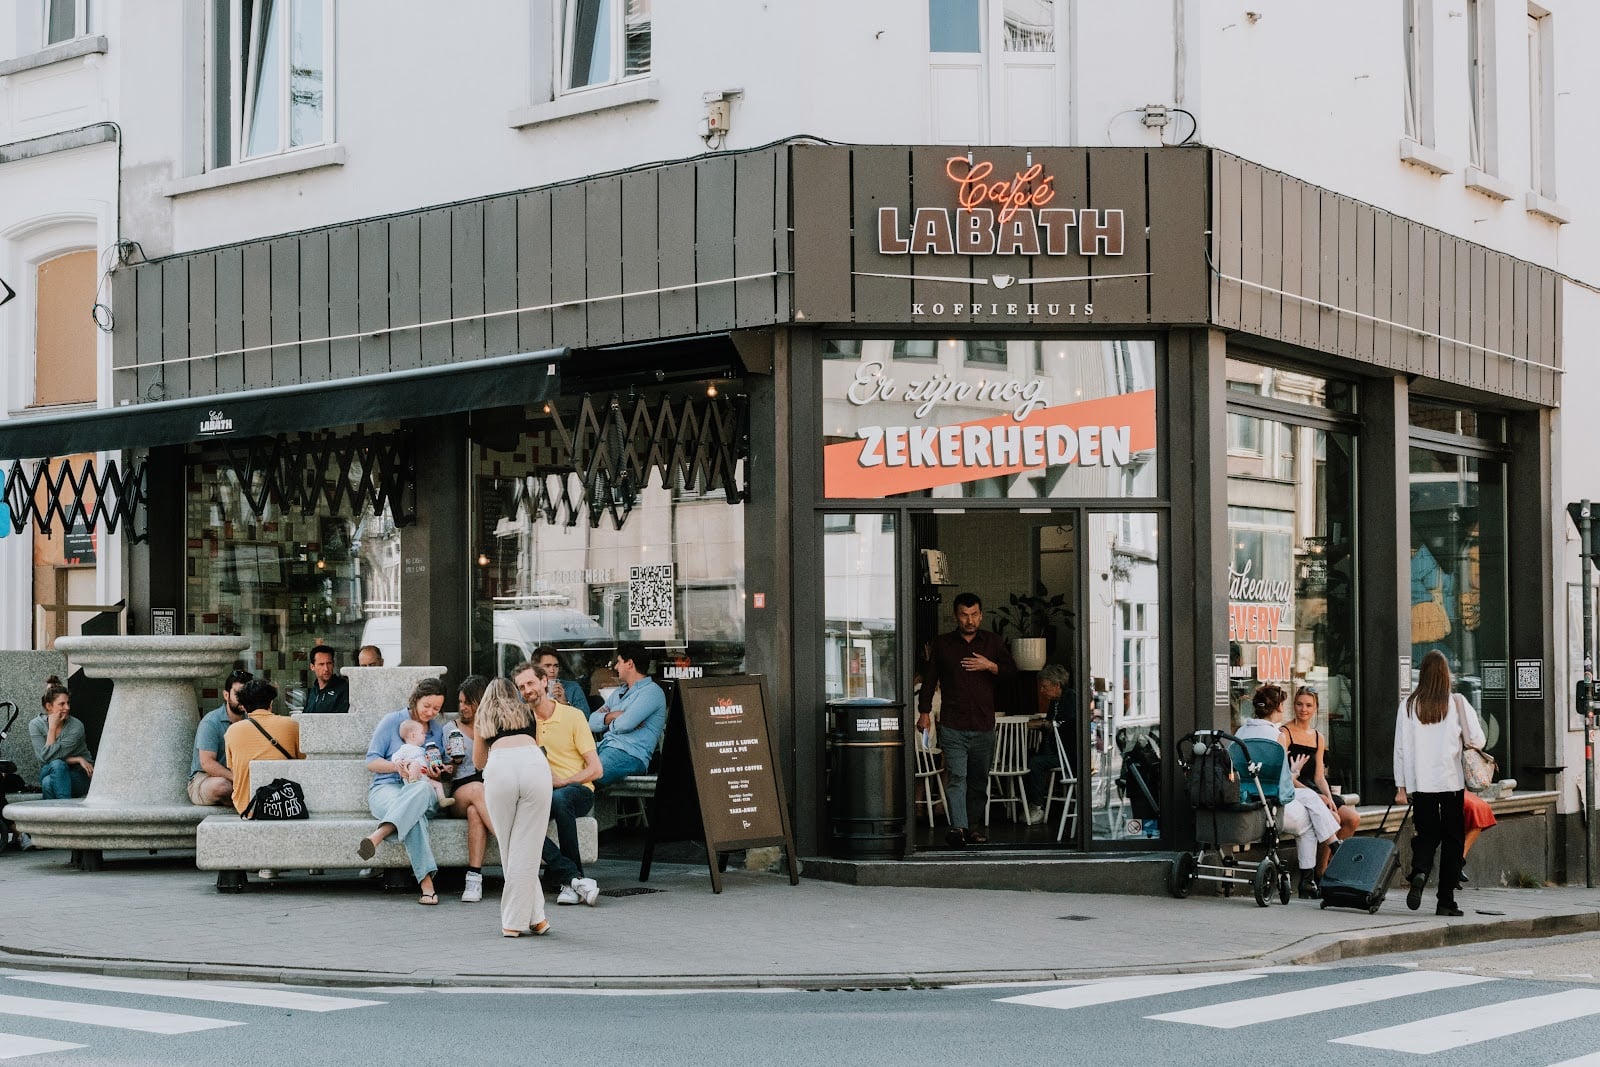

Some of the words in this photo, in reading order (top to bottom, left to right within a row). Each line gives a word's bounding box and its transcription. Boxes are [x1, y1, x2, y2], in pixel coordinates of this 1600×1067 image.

[946, 156, 1055, 223] Café
[878, 206, 1125, 255] LABATH
[911, 303, 1095, 316] KOFFIEHUIS
[847, 361, 897, 405] Er
[903, 372, 974, 419] zijn
[974, 377, 1047, 422] nog
[200, 419, 233, 432] LABATH
[857, 425, 1131, 468] ZEKERHEDEN
[585, 569, 612, 583] HERE
[1229, 604, 1281, 643] EVERY
[1257, 645, 1293, 683] DAY
[664, 666, 703, 679] LABATH
[709, 705, 743, 716] LABATH
[740, 738, 759, 746] LUNCH
[744, 764, 763, 772] COFFEE
